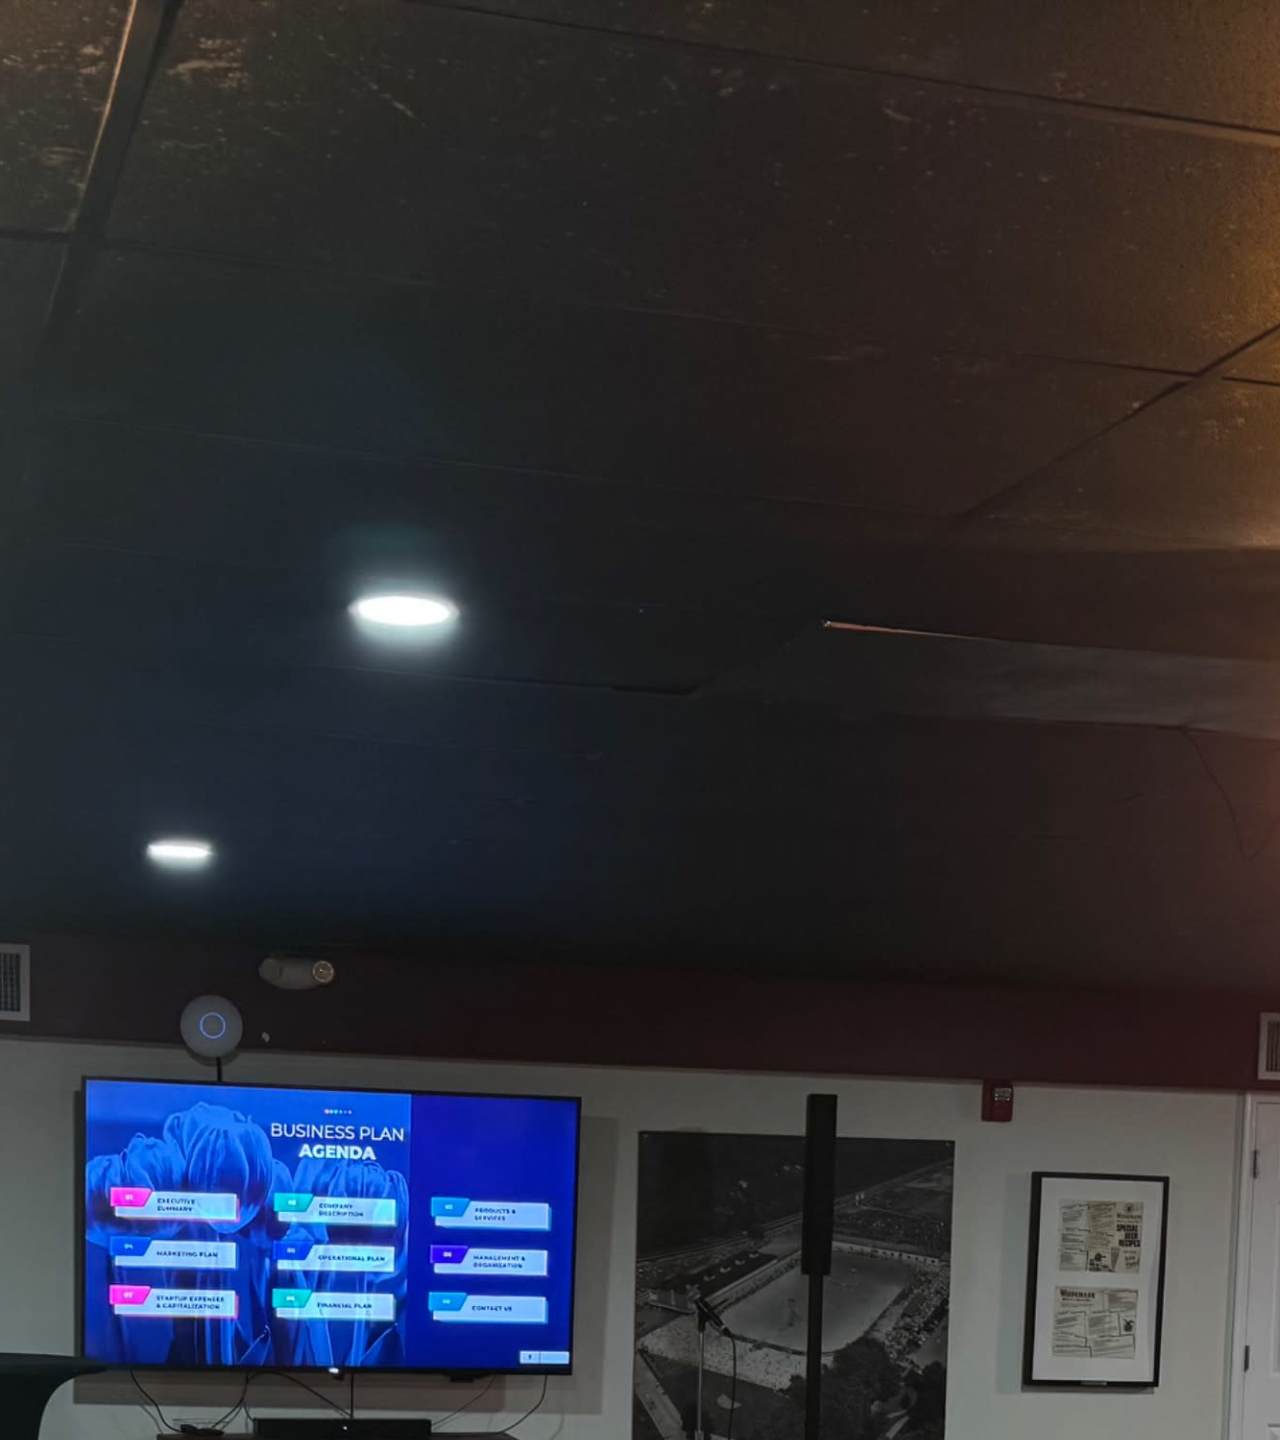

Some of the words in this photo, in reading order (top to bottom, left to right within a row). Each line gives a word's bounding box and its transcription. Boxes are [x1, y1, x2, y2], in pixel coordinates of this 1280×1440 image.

[271, 1122, 355, 1140] BUSINESS
[359, 1126, 404, 1141] PLAN
[298, 1143, 376, 1160] AGENDA
